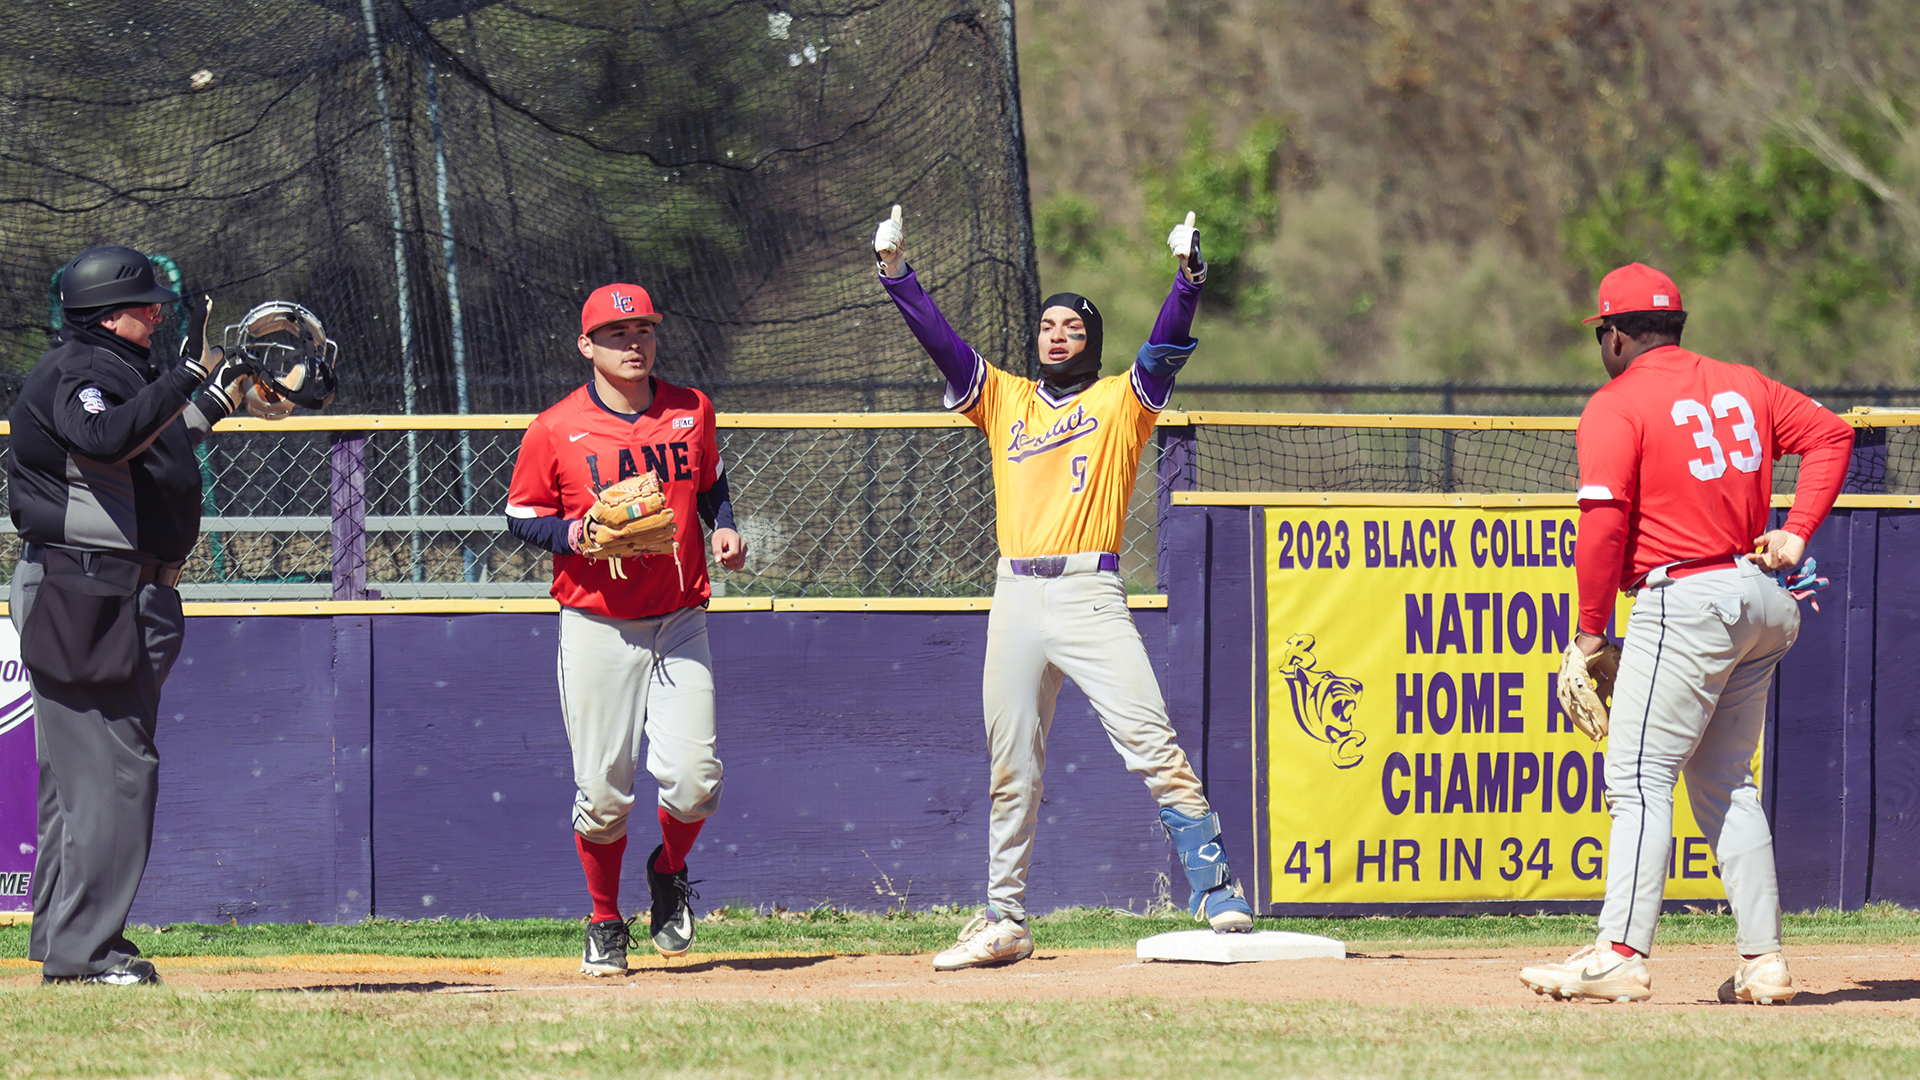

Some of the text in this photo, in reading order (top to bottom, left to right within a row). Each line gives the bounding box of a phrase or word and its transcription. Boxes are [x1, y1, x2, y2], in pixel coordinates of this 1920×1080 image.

[611, 291, 635, 314] LC
[1671, 390, 1763, 482] 33
[586, 441, 692, 493] LANE
[1071, 455, 1088, 493] 9
[1279, 519, 1577, 569] 2023 BLACK COLLEG
[1405, 591, 1624, 655] NATION
[1396, 672, 1524, 735] HOME
[1284, 840, 1331, 883] 41
[1356, 839, 1420, 882] HR
[1440, 838, 1482, 881] IN
[1499, 837, 1553, 881] 34
